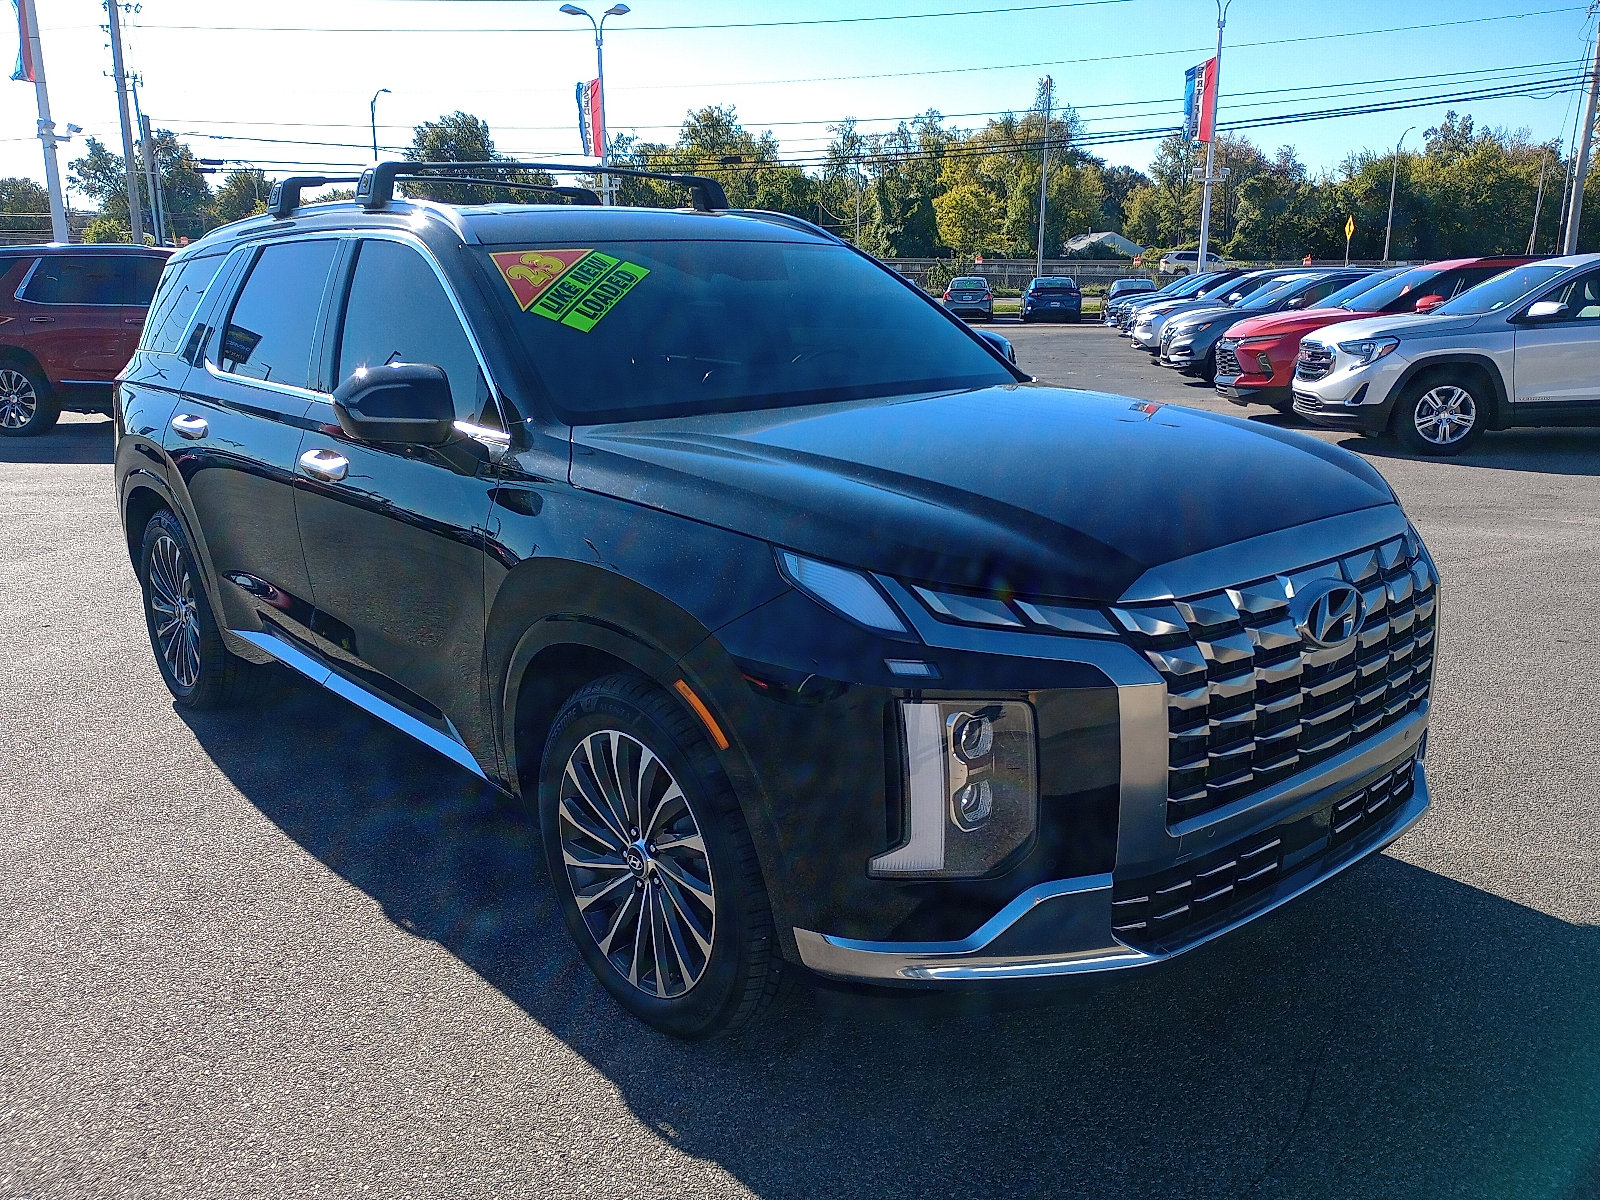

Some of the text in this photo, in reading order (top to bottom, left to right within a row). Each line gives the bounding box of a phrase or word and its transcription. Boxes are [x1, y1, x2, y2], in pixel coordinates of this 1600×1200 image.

[539, 255, 612, 315] LIKE NEW
[574, 269, 639, 321] LOADED
